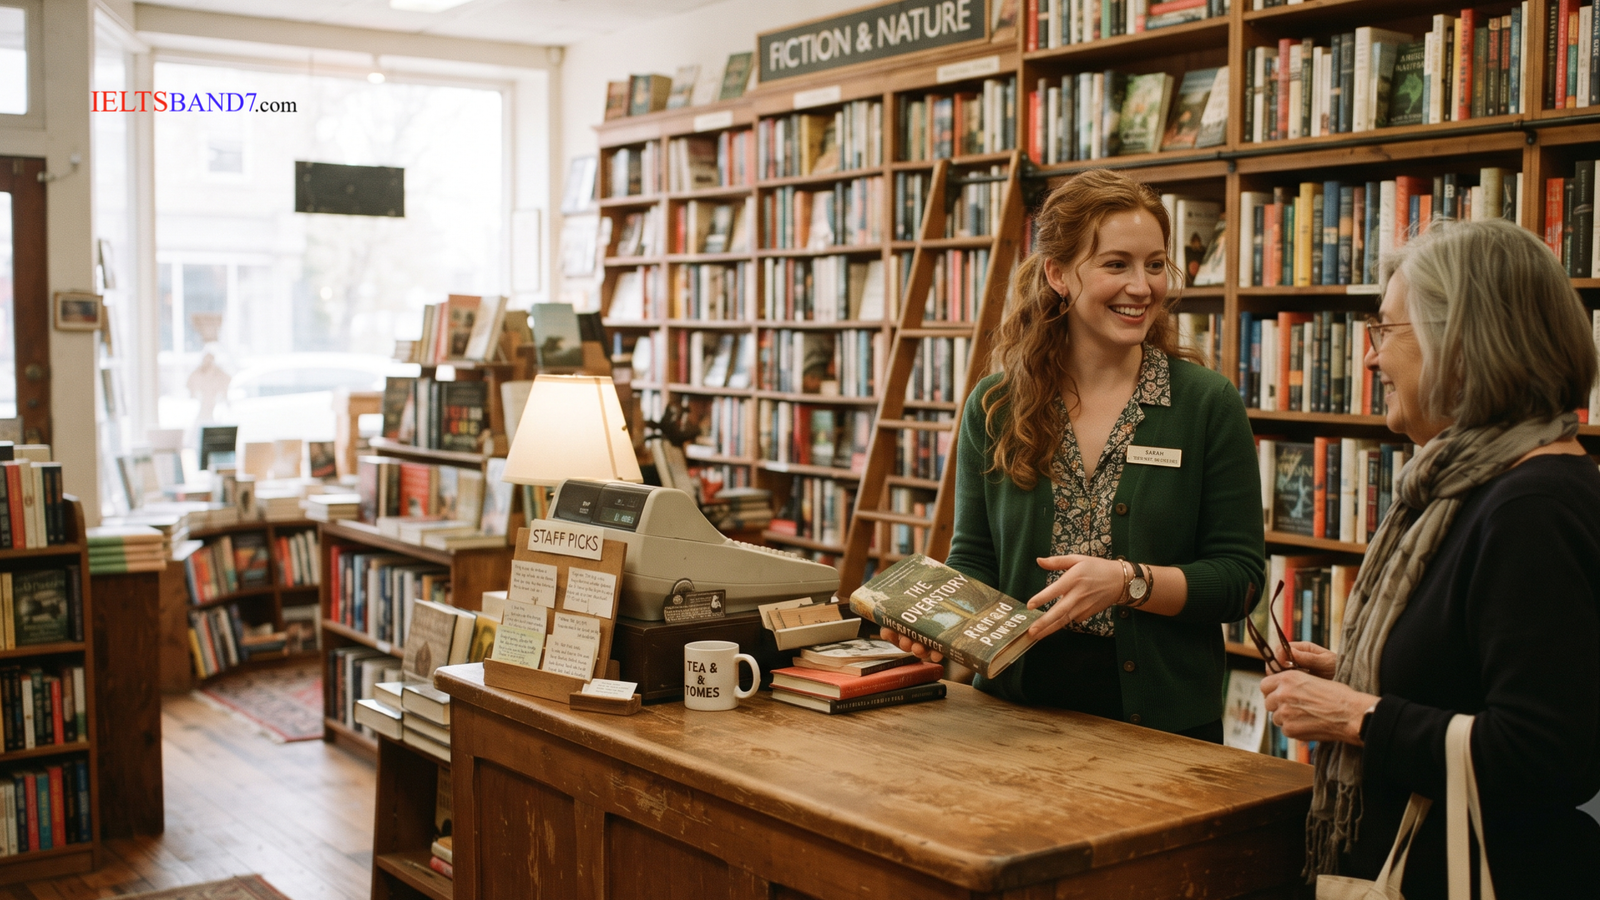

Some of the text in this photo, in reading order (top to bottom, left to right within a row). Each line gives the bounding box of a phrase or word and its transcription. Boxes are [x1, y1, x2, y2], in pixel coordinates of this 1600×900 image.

[769, 0, 971, 71] FICTION & NATURE
[533, 529, 599, 551] STAFF PICKS
[901, 573, 969, 624] OVERSTORY
[903, 579, 933, 599] THE
[687, 660, 718, 674] TEA &
[697, 675, 705, 685] &
[685, 685, 720, 698] TOMES
